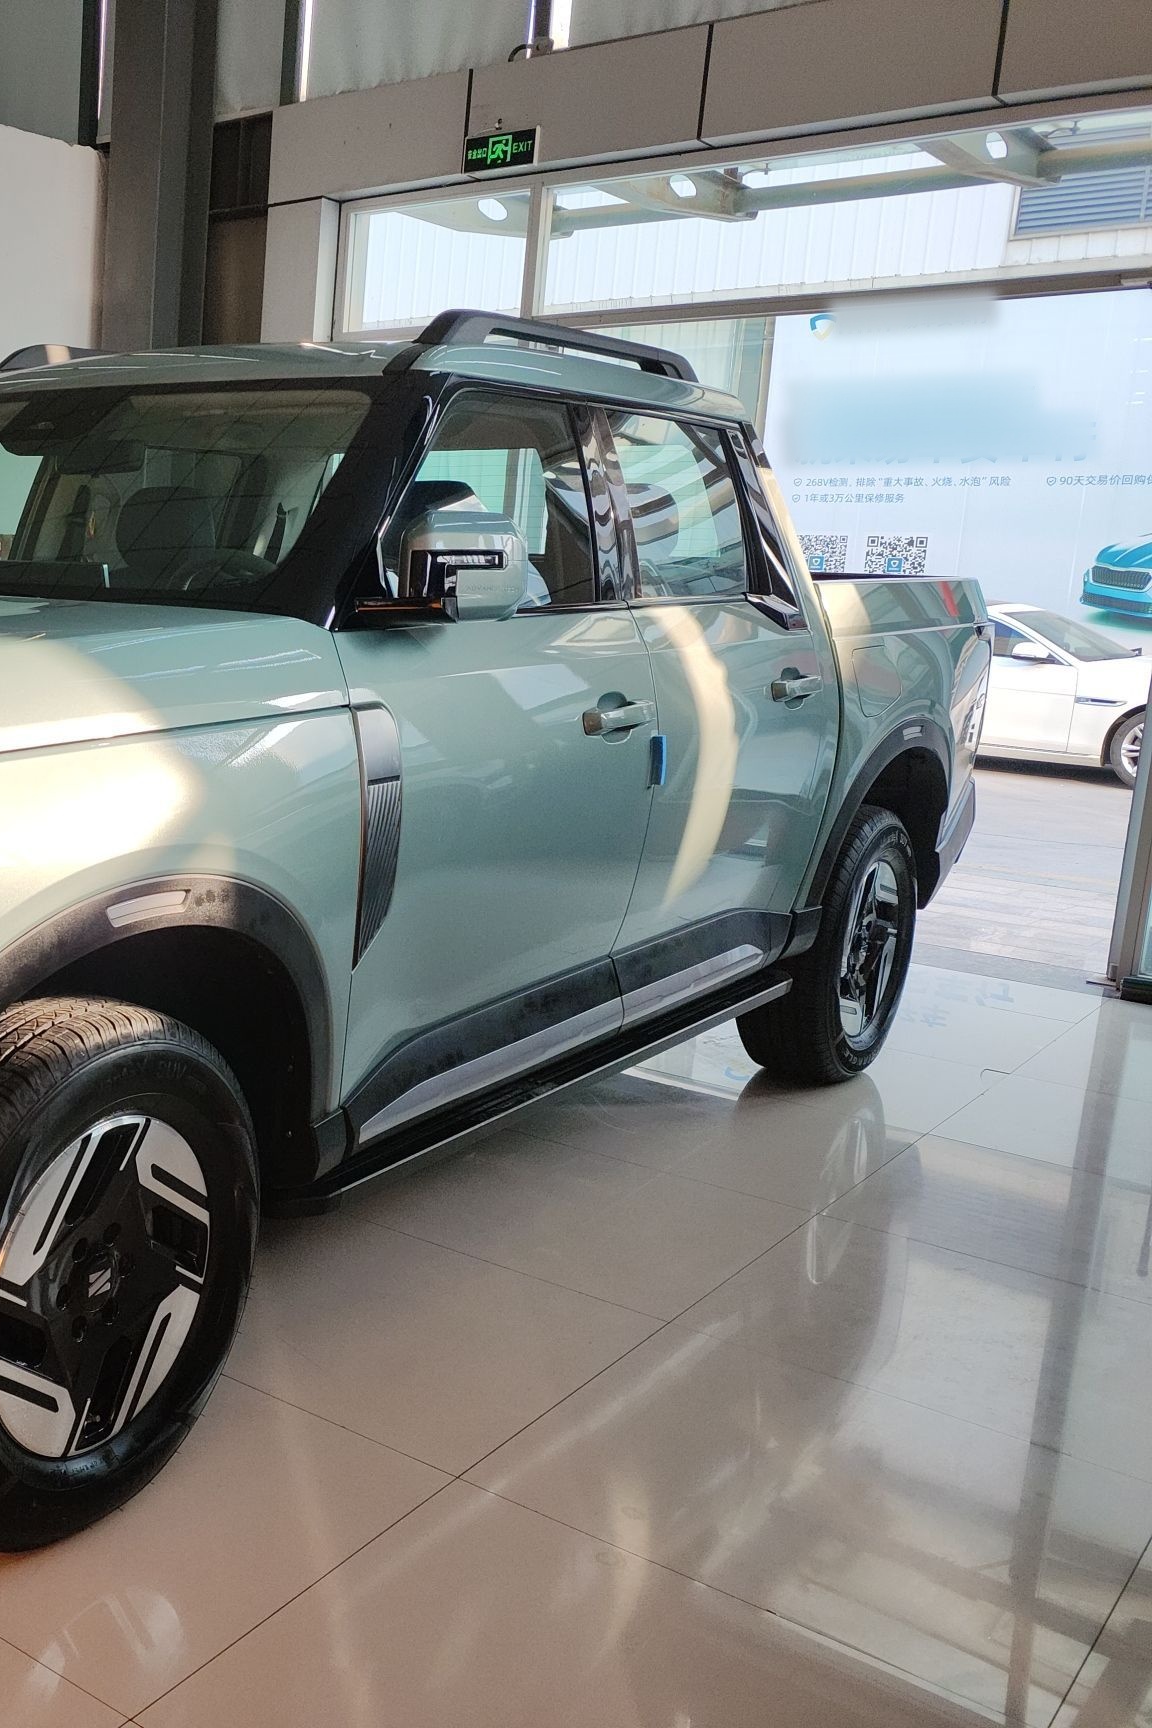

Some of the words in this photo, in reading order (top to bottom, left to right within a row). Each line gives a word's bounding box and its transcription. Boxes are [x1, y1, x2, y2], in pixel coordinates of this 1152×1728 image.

[512, 140, 533, 153] EXIT
[467, 147, 488, 160] 安全出口
